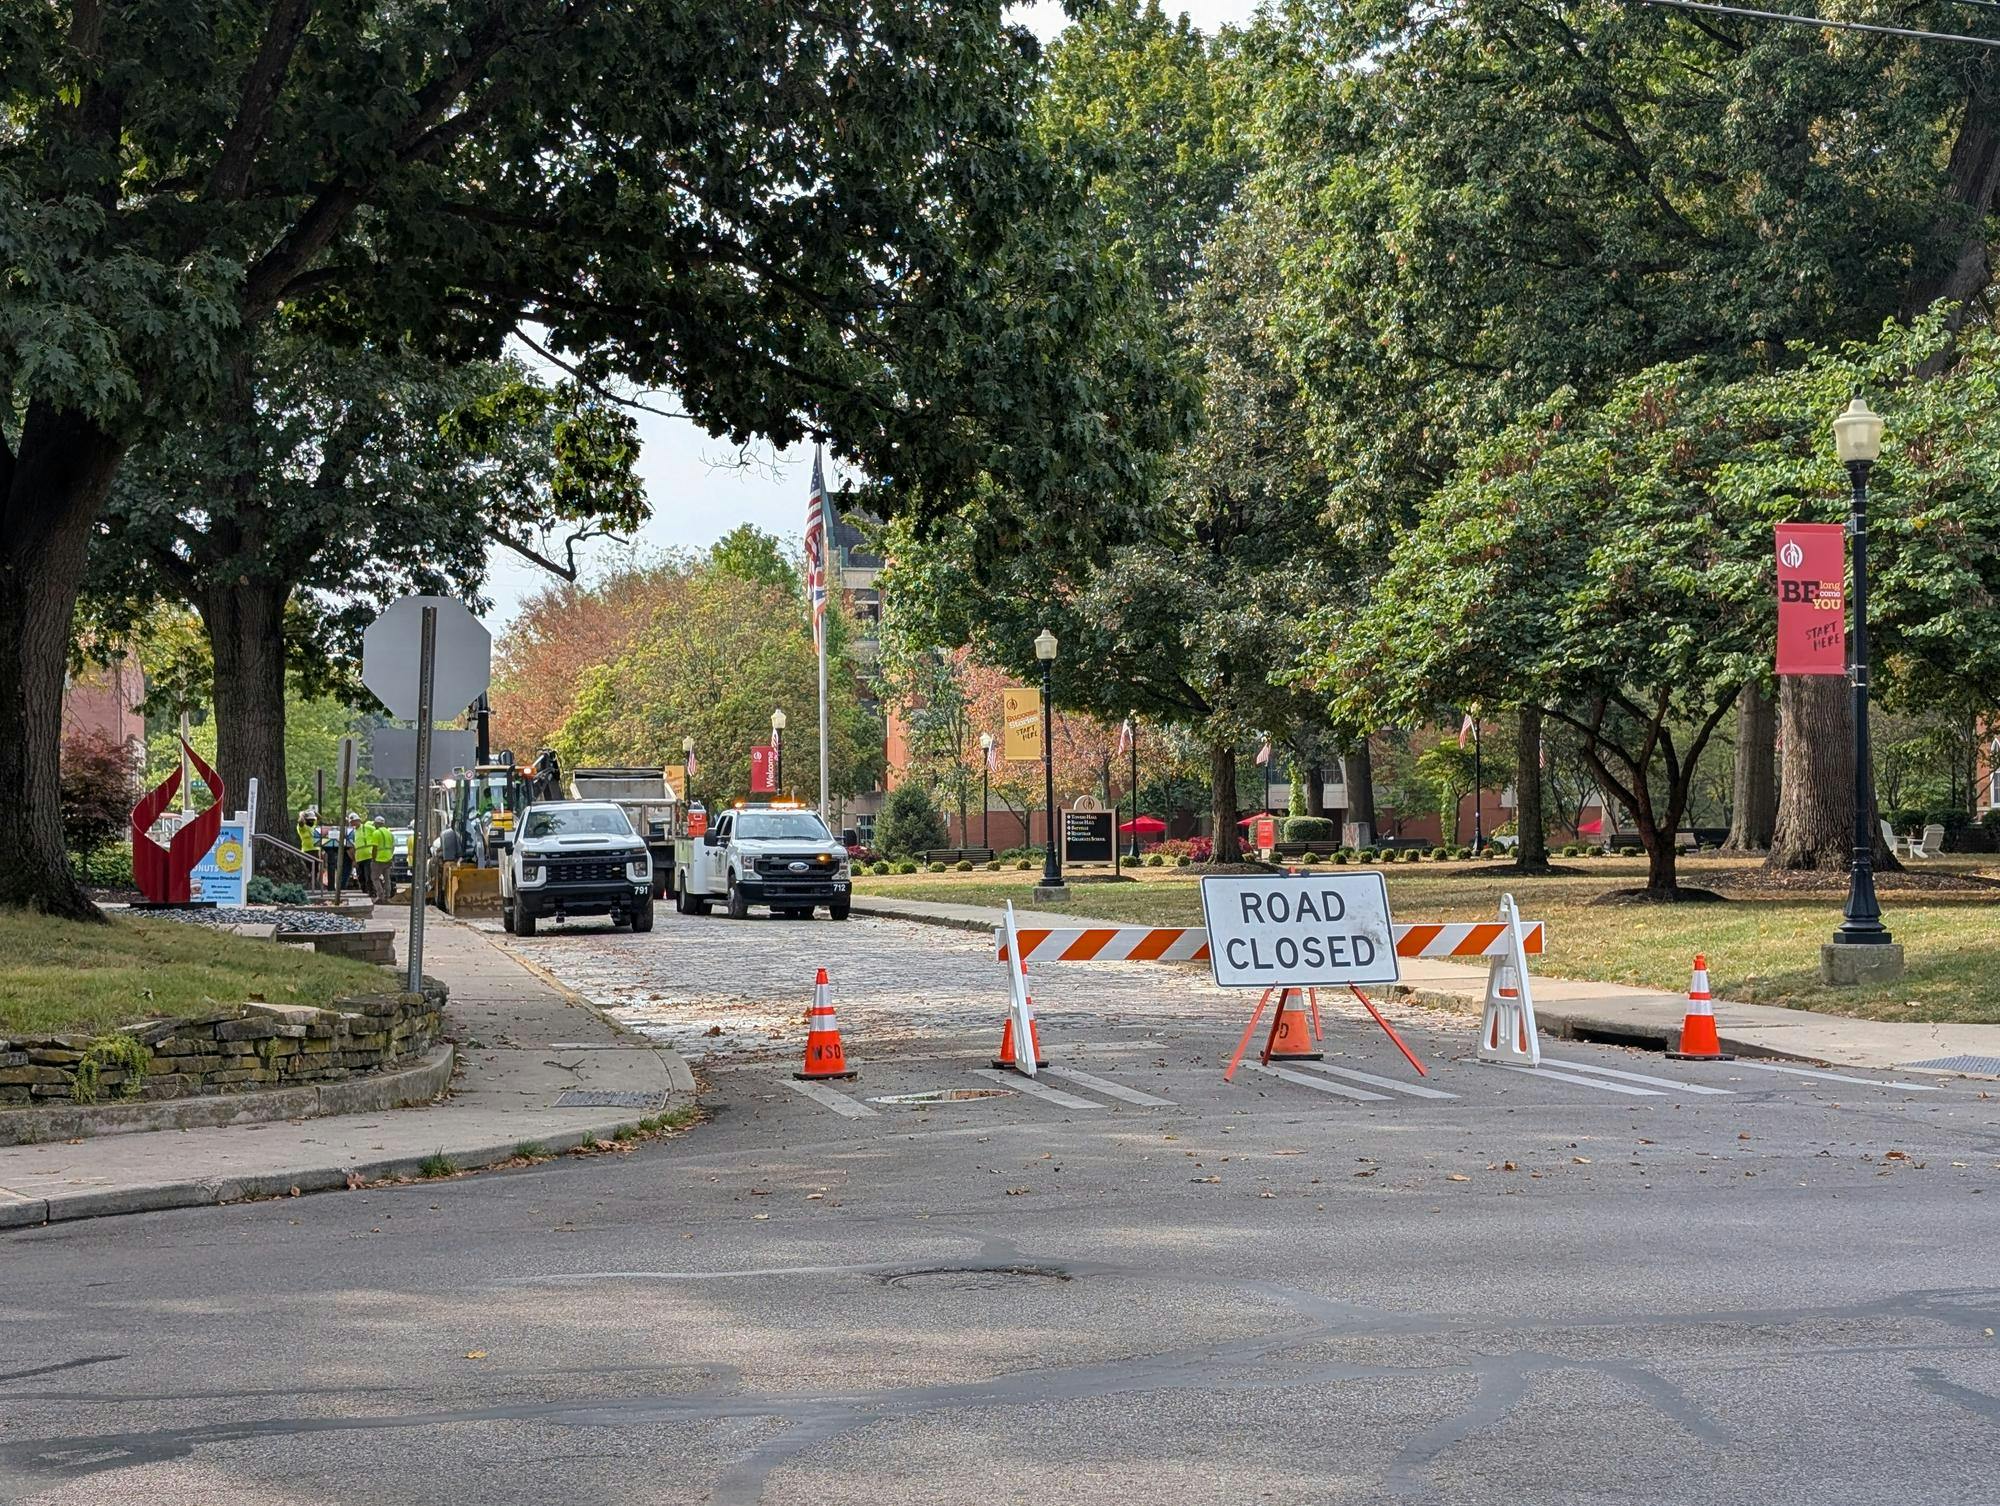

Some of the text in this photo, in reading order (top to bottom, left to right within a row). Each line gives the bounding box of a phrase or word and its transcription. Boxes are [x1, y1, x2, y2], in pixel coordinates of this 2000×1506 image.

[1781, 580, 1820, 603] BE
[1820, 580, 1840, 591] long
[1813, 598, 1841, 610] YOU
[1805, 621, 1838, 640] START
[1813, 633, 1840, 651] HERE
[766, 751, 774, 788] Welcome
[634, 886, 648, 895] 791
[833, 884, 846, 892] 712
[1240, 890, 1346, 924] ROAD
[1226, 935, 1376, 970] CLOSED
